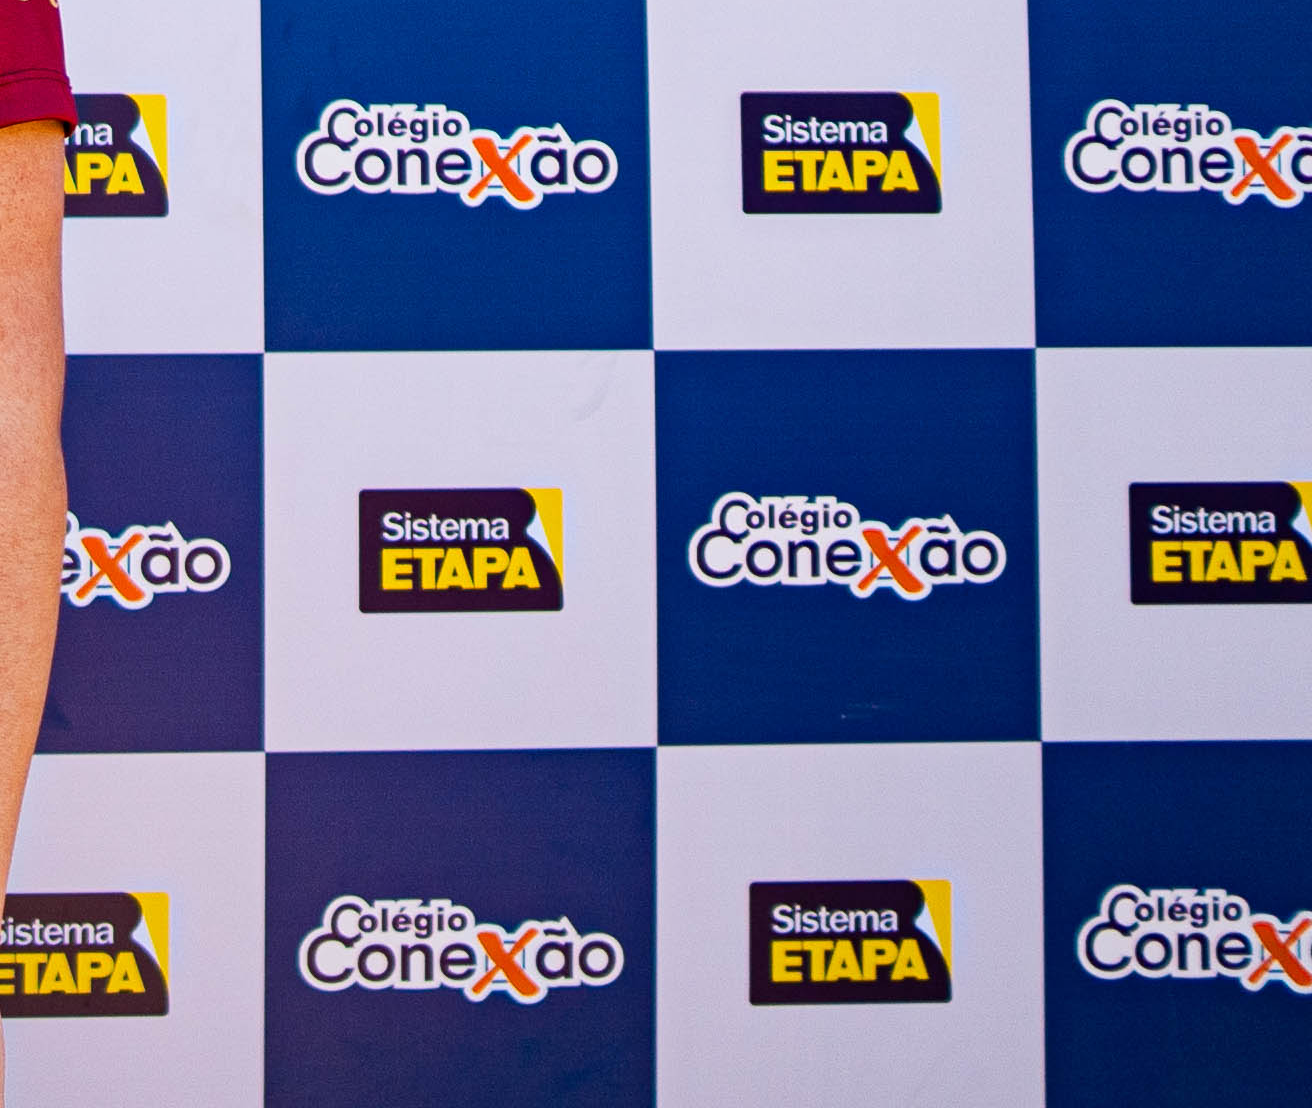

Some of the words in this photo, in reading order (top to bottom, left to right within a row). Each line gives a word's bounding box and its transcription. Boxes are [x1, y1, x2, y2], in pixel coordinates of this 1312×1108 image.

[328, 107, 462, 145] Colégio
[763, 114, 888, 143] Sistema
[1094, 106, 1225, 144] Colégio
[763, 150, 920, 192] ETAPA
[382, 511, 510, 541] Sistema
[719, 499, 852, 537] Colégio
[1152, 505, 1276, 535] Sistema
[381, 547, 541, 591] ETAPA
[1151, 540, 1308, 583] ETAPA
[330, 903, 467, 941] Colégio
[772, 904, 899, 934] Sistema
[1108, 891, 1243, 929] Colégio
[771, 939, 930, 984] ETAPA
